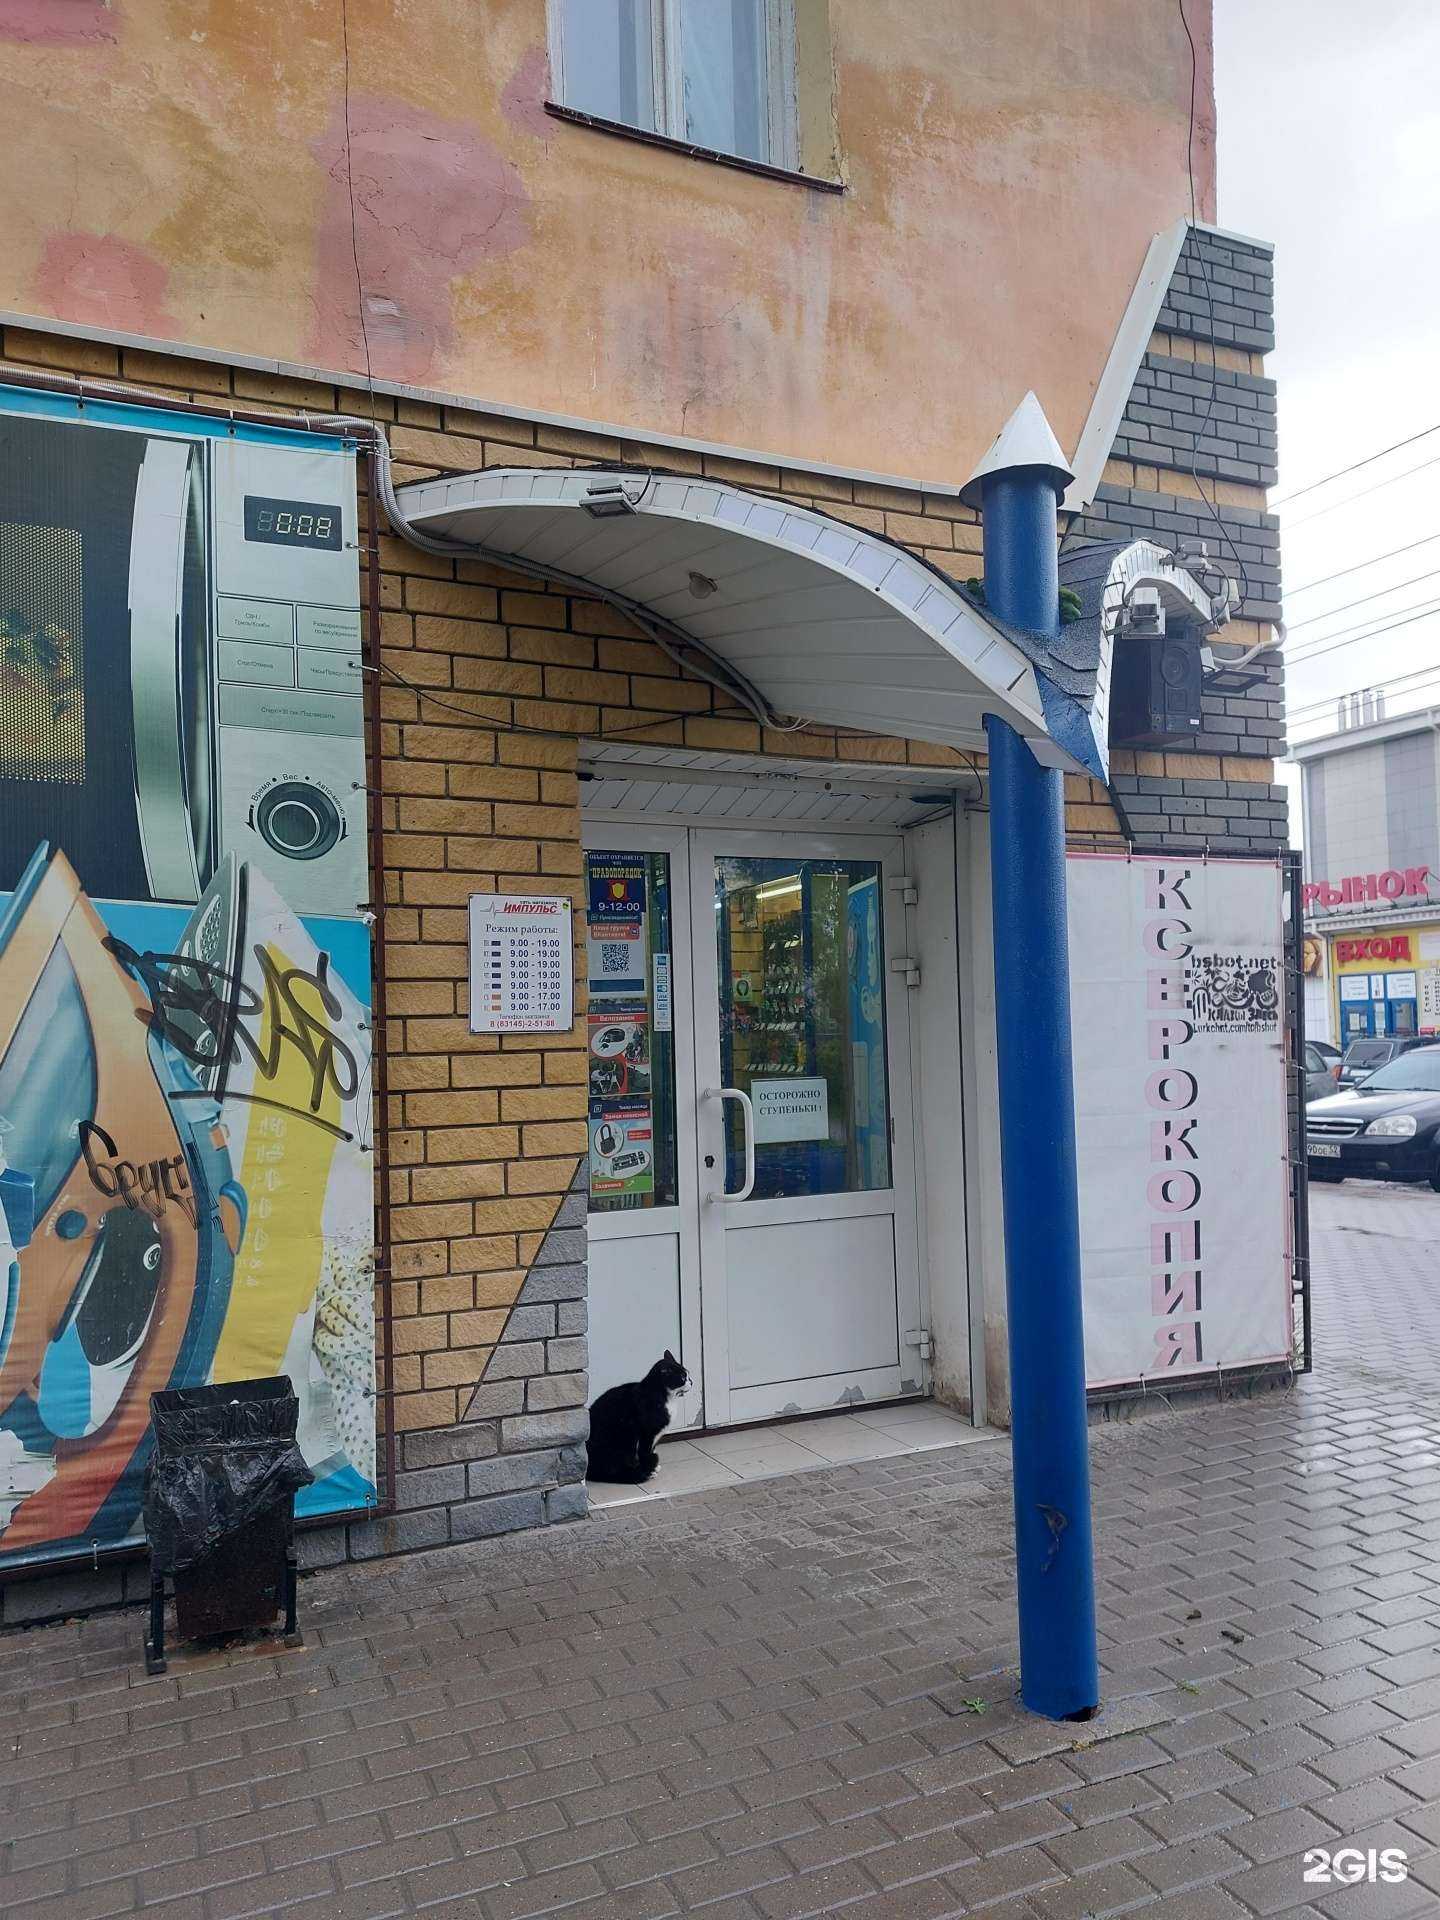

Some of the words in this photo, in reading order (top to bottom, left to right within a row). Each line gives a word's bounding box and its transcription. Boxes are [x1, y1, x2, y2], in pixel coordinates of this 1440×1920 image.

[282, 773, 299, 781] Вес
[251, 781, 272, 802] Время
[1303, 866, 1430, 909] РЫНОК
[503, 901, 558, 914] ИМПУЛЬС
[598, 902, 640, 911] 9-12-00
[485, 924, 518, 934] Режим
[520, 926, 558, 936] работы:
[537, 940, 560, 948] 19.00
[537, 950, 560, 958] 19.00
[1336, 936, 1412, 964] ВХОД
[537, 961, 560, 969] 19.00
[537, 971, 560, 979] 19.00
[537, 982, 560, 990] 19.00
[537, 993, 560, 1001] 17.00
[537, 1003, 560, 1011] 17.00
[760, 1089, 821, 1101] ОСТОРОЖНО
[760, 1104, 817, 1115] СТУПЕНЬКИ
[1142, 868, 1203, 1368] КСЕРОКОПИЯ
